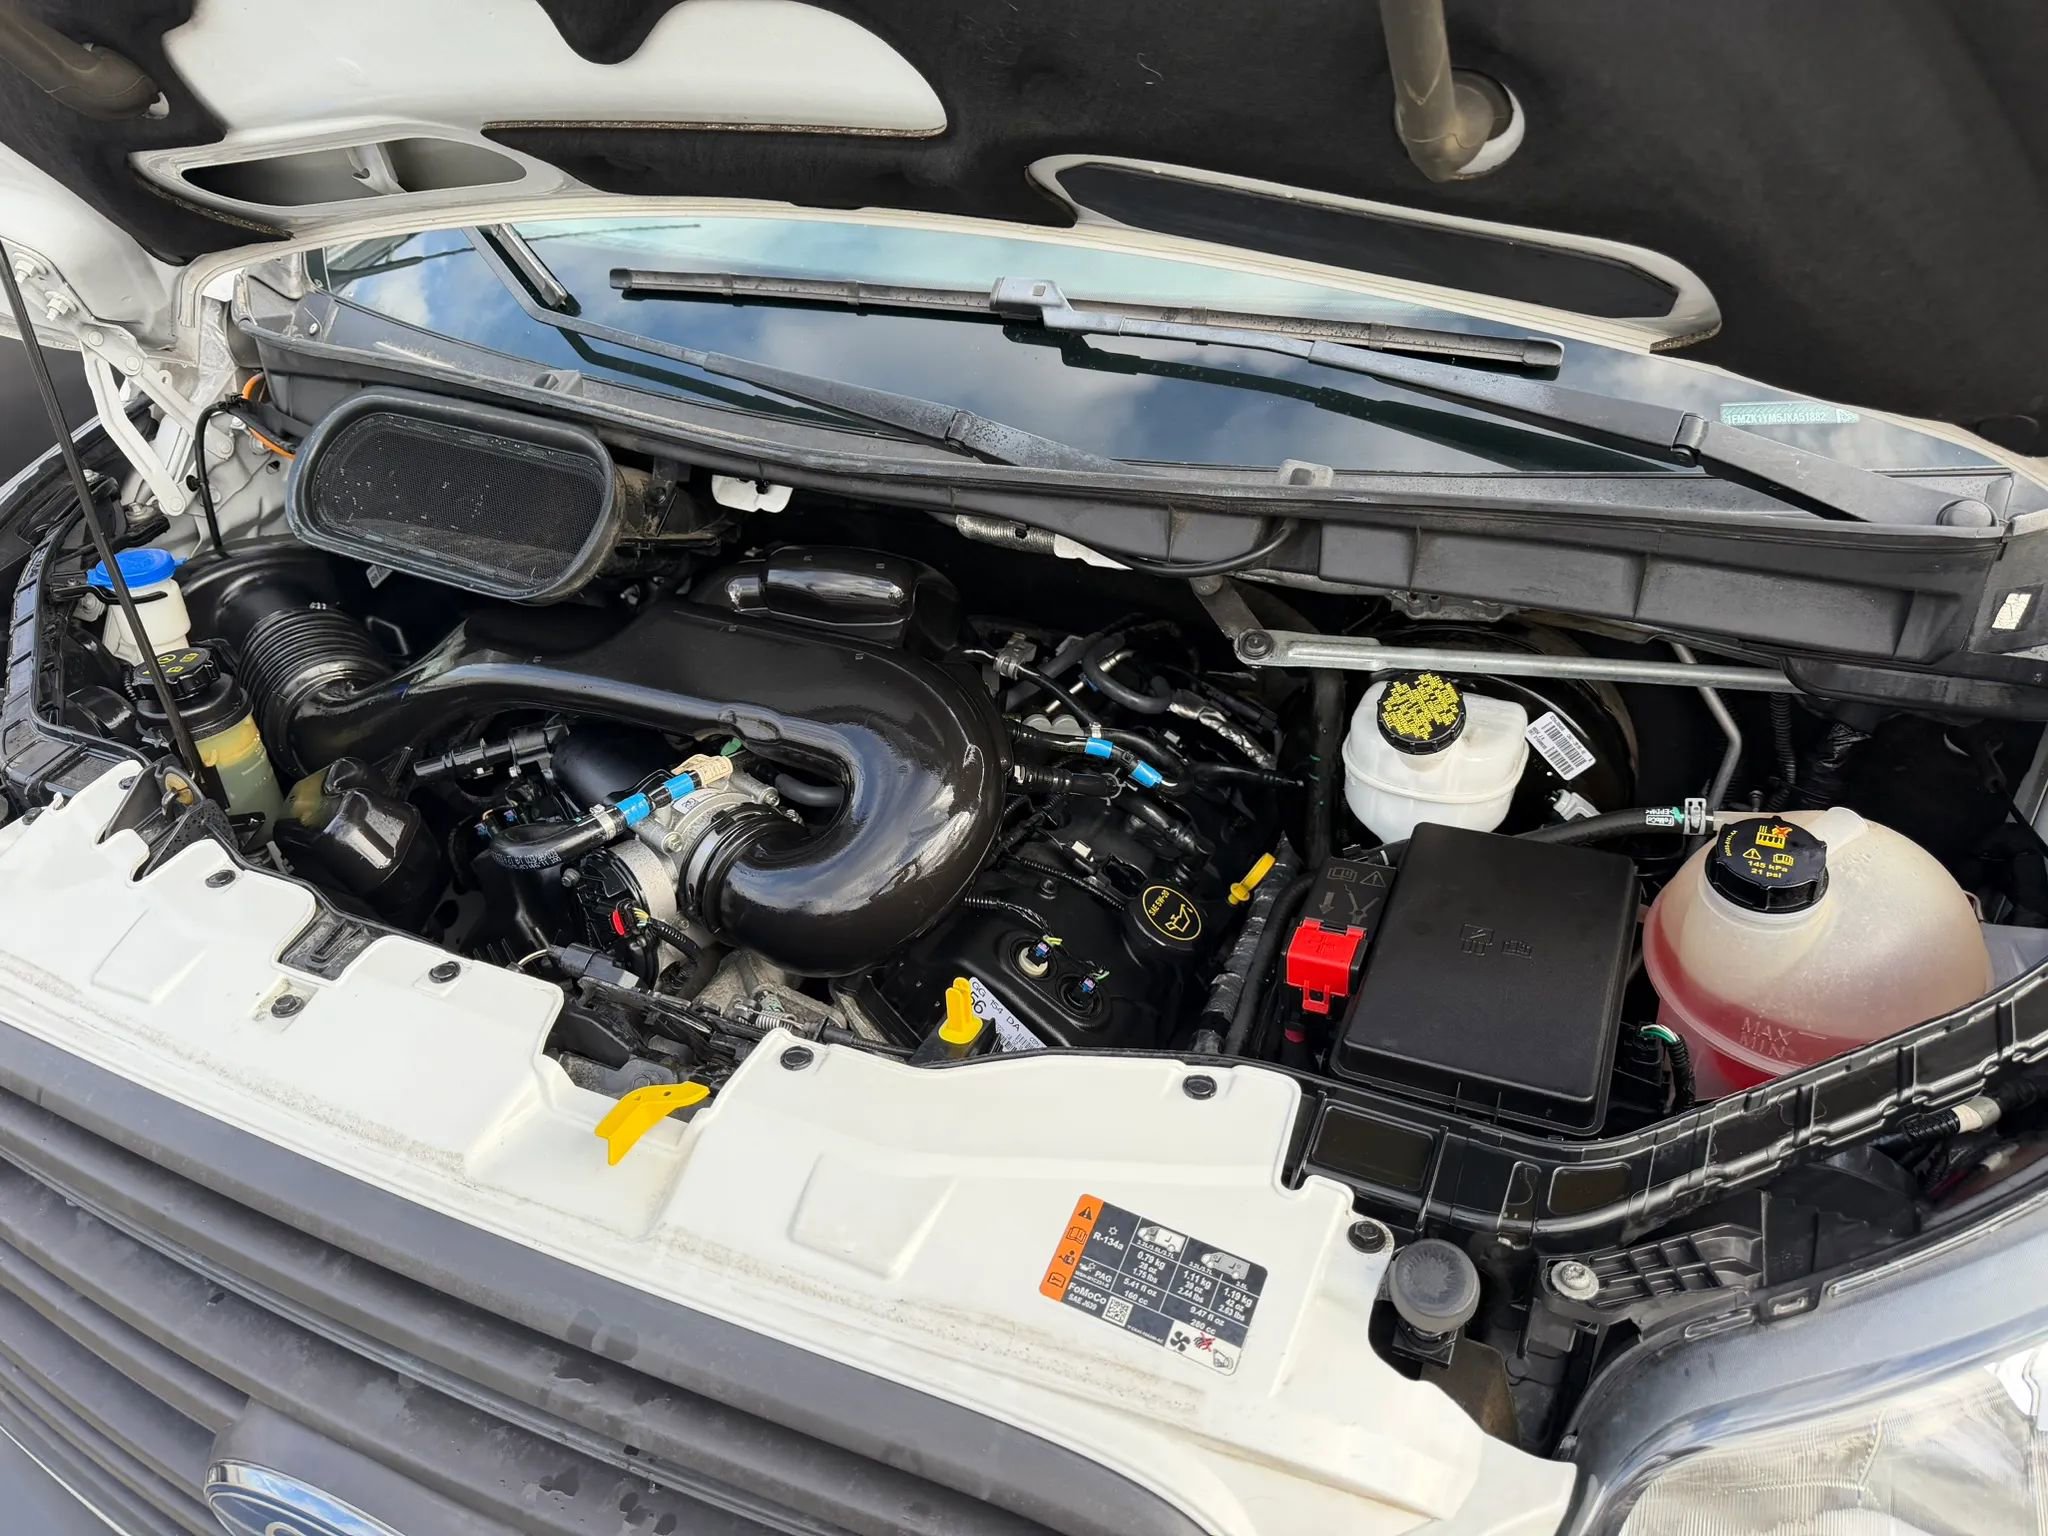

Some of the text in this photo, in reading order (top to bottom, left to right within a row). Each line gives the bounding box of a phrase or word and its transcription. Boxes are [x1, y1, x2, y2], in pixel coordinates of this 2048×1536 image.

[1748, 861, 1788, 872] 145 kPa
[1148, 889, 1170, 917] SAE 5W-20
[972, 981, 987, 997] GG
[990, 999, 1004, 1014] 154
[1006, 1016, 1020, 1032] DA
[1740, 1016, 1792, 1046] MAX
[1093, 1231, 1124, 1250] R-134a
[1136, 1250, 1166, 1271] 0.79 kg
[1094, 1270, 1113, 1283] PAG
[1132, 1267, 1158, 1284] 1.75 lbs
[1148, 1266, 1158, 1275] oz
[1123, 1278, 1158, 1297] 5.41 fl oz
[1183, 1270, 1212, 1290] 1.11 kg
[1067, 1281, 1107, 1305] FoMoCo
[1177, 1287, 1205, 1303] 2.44 lbs
[1194, 1286, 1204, 1294] oz
[1224, 1287, 1253, 1308] 1.19 kg
[1068, 1293, 1082, 1306] SAE
[1138, 1297, 1149, 1305] cc
[1224, 1298, 1245, 1312] 42 oz
[1189, 1306, 1225, 1327] 9.47 fl oz
[1234, 1311, 1245, 1321] lbs
[1205, 1326, 1217, 1335] cc
